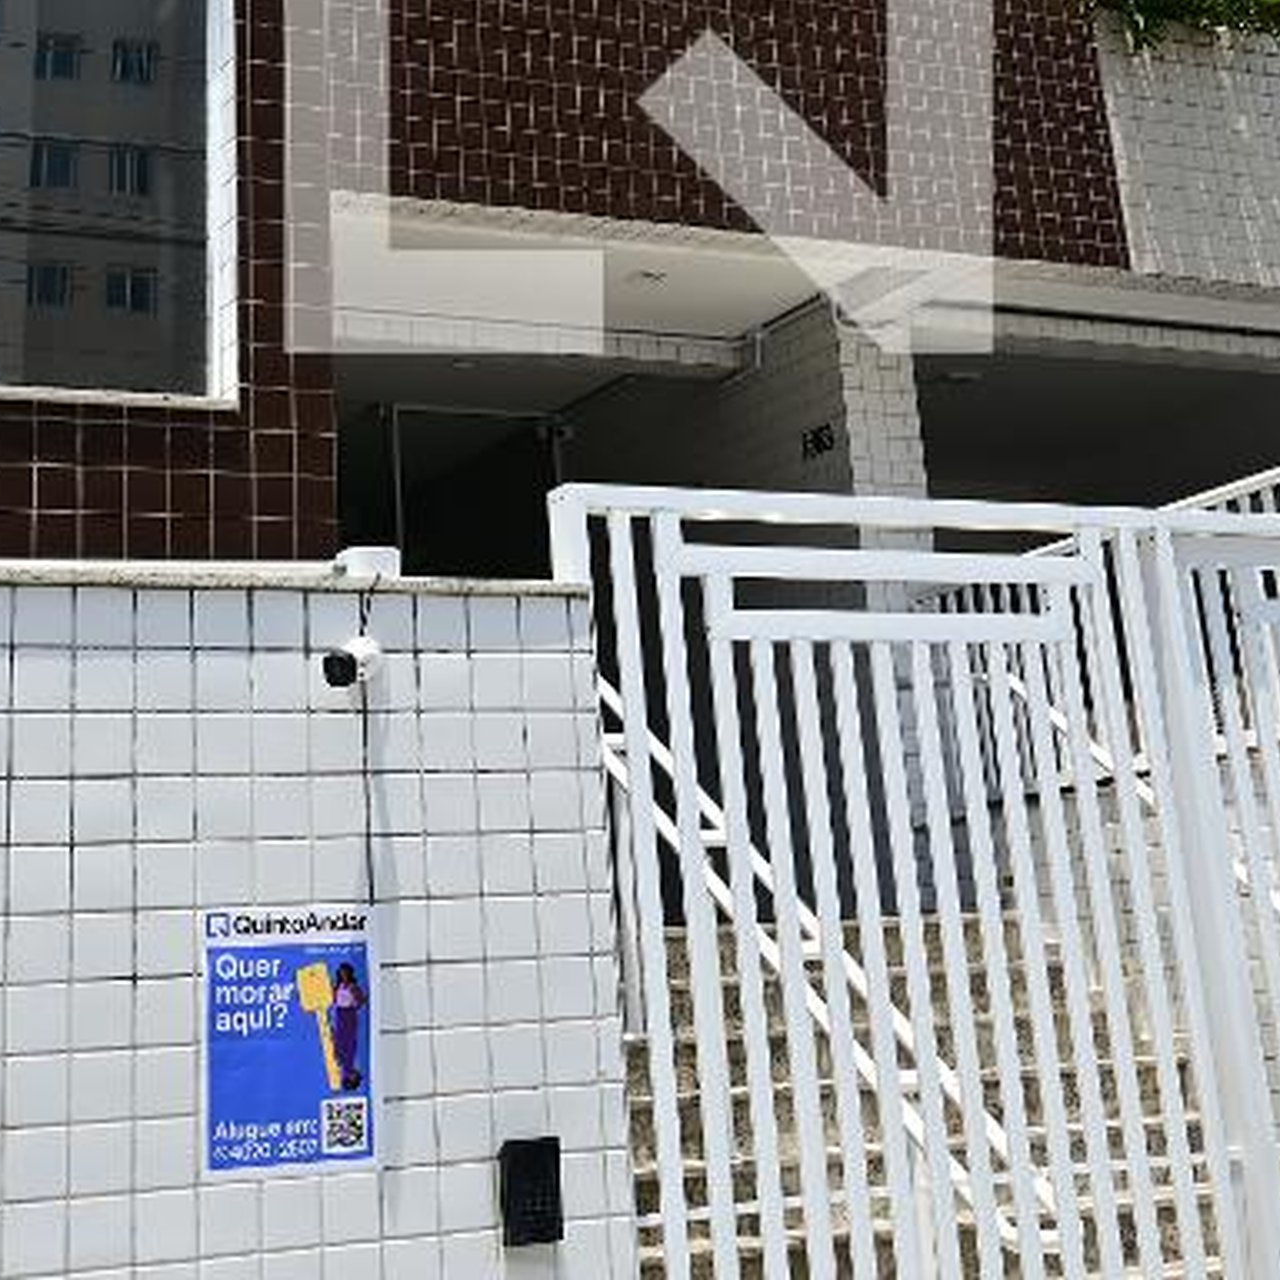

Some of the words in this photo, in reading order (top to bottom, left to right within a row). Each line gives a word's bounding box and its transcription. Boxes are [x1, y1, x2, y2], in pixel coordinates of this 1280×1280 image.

[232, 912, 368, 935] QuintoAndar
[214, 953, 282, 980] Quer
[214, 981, 294, 1005] morar
[214, 1004, 289, 1037] aqui?
